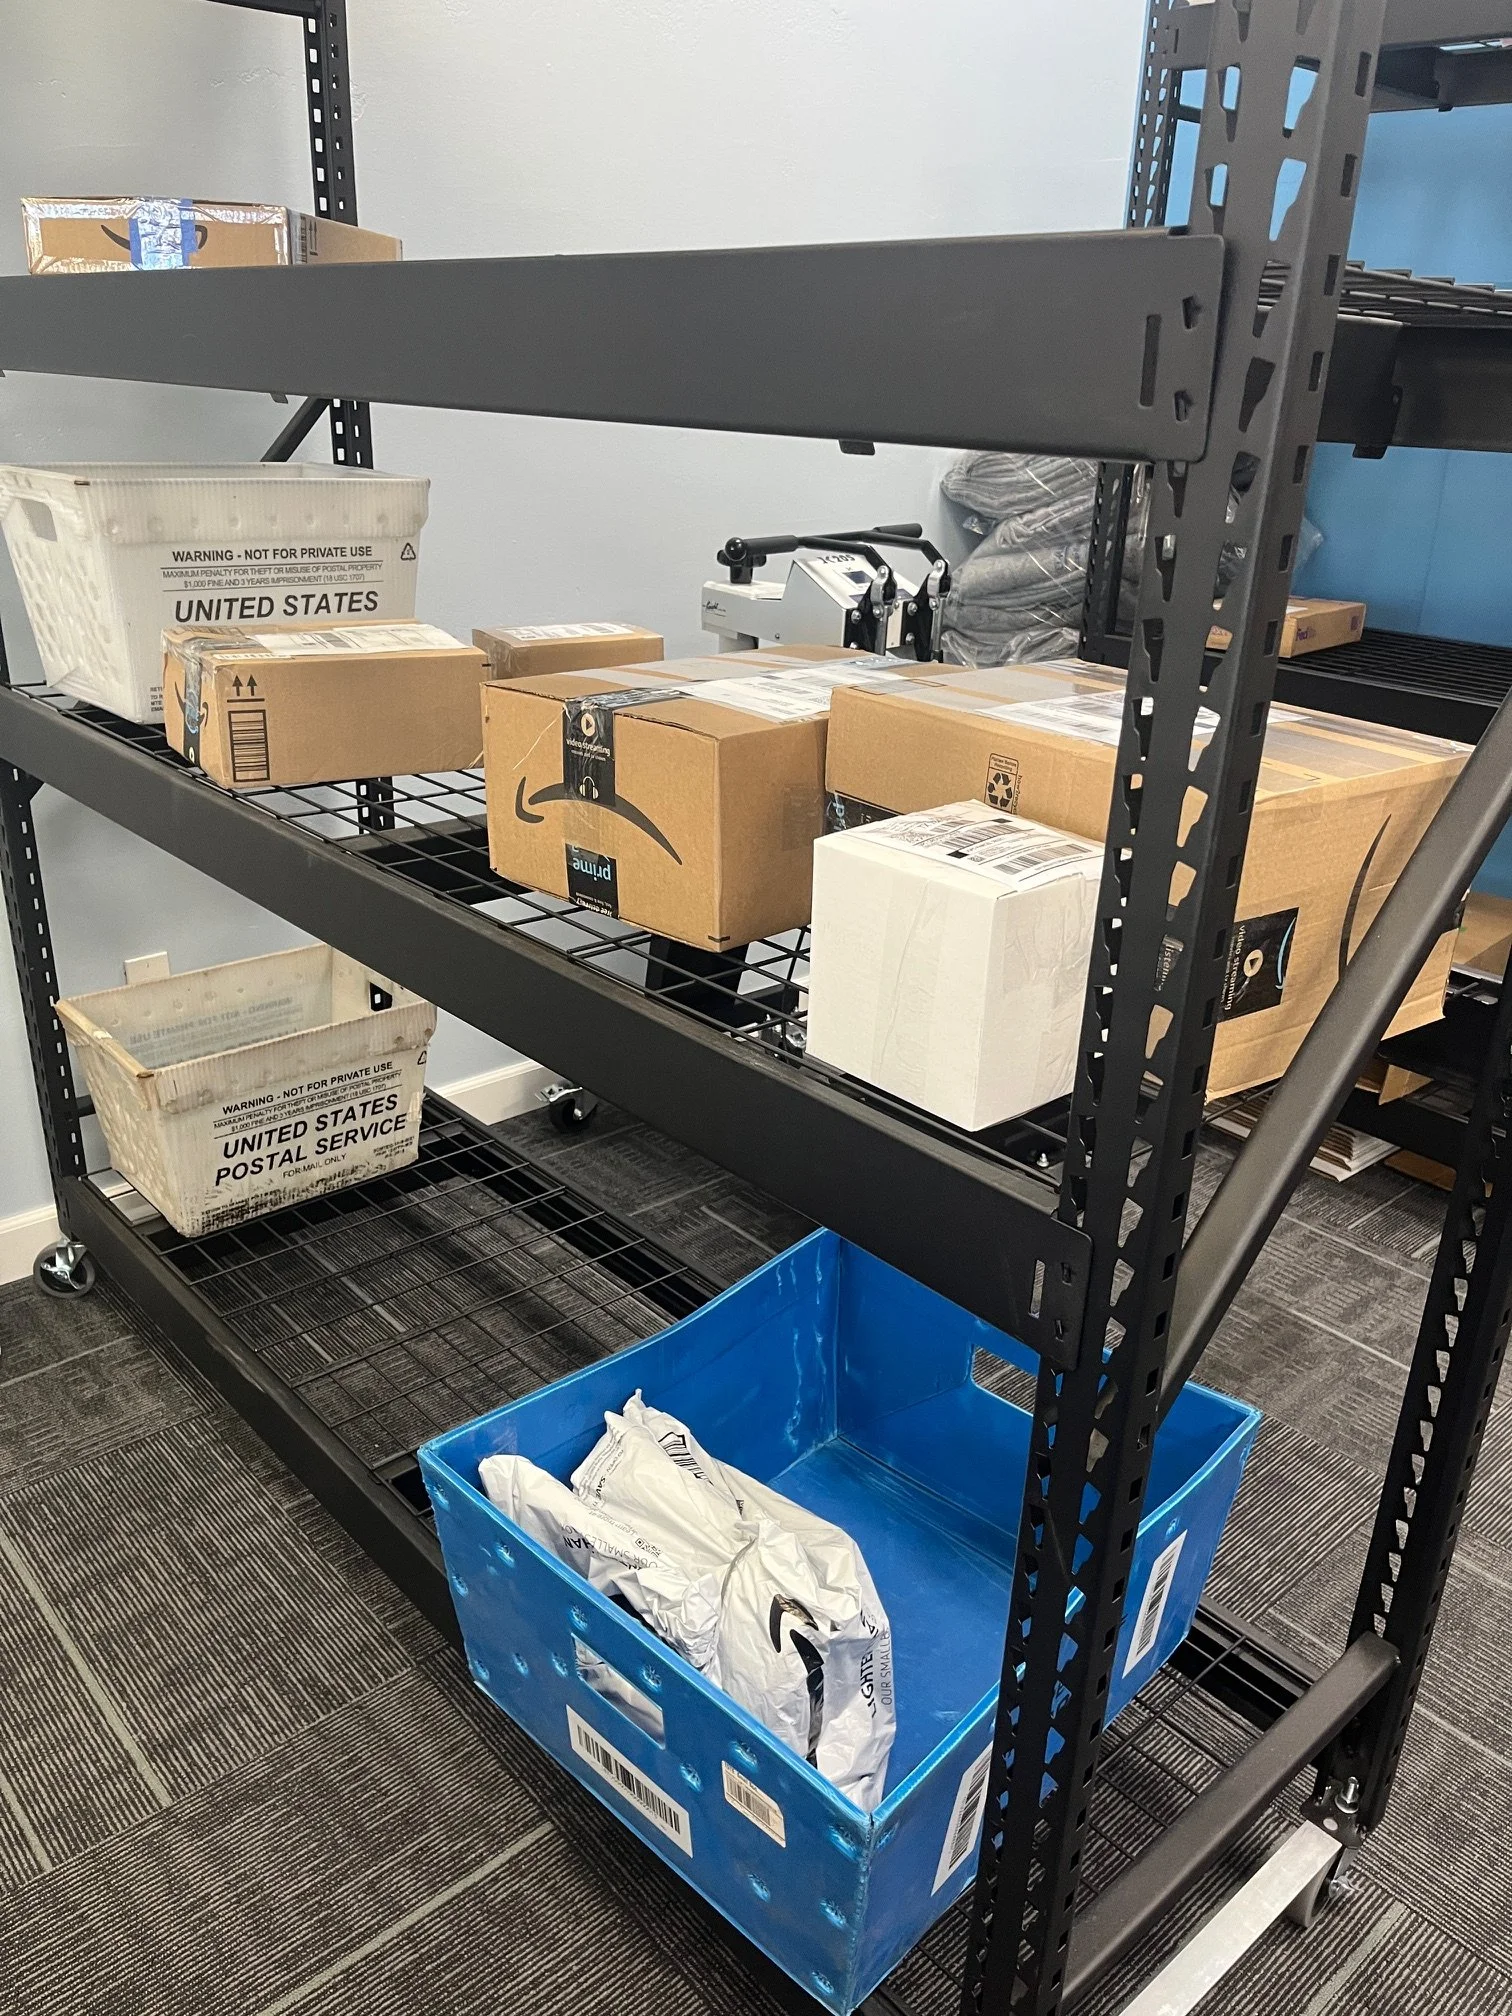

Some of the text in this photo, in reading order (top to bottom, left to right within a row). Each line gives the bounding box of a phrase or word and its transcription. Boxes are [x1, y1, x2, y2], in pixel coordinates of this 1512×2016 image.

[172, 550, 234, 562] WARNING
[244, 549, 270, 560] NOT
[272, 548, 298, 560] FOR
[300, 546, 347, 558] PRIVATE
[350, 546, 372, 557] USE
[162, 563, 382, 578] MAXIMUM PENALTY FOR THEFT OR MISUSE OF POSTAL PROPERTY
[184, 580, 206, 589] $1,000
[246, 578, 270, 586] YEARS
[271, 575, 322, 584] IMPRISONMENT
[334, 574, 348, 582] USC
[175, 590, 379, 623] UNITED STATES
[566, 738, 610, 757] video streaming
[572, 858, 612, 881] prime
[1224, 925, 1246, 1011] video streaming
[214, 1116, 245, 1128] MAXIMUM
[245, 1108, 272, 1120] PENALTY
[274, 1103, 287, 1112] FOR
[288, 1098, 306, 1108] THEFT
[306, 1096, 316, 1104] OR
[340, 1086, 348, 1094] OF
[349, 1081, 370, 1092] POSTAL
[372, 1072, 402, 1084] PROPERTY
[222, 1094, 274, 1115] WARNING
[283, 1086, 304, 1098] NOT
[307, 1080, 328, 1092] FOR
[330, 1067, 370, 1085] PRIVATE
[374, 1061, 393, 1074] USE
[223, 1093, 398, 1159] UNITED STATES
[266, 1114, 278, 1122] AND
[284, 1106, 304, 1117] YEARS
[215, 1144, 308, 1187] POSTAL
[315, 1113, 407, 1155] SERVICE
[282, 1152, 346, 1179] FOR MAIL ONLY
[596, 1476, 606, 1500] SAVE
[585, 1533, 631, 1561] SMALLES
[880, 1624, 892, 1706] OUR SMALLE
